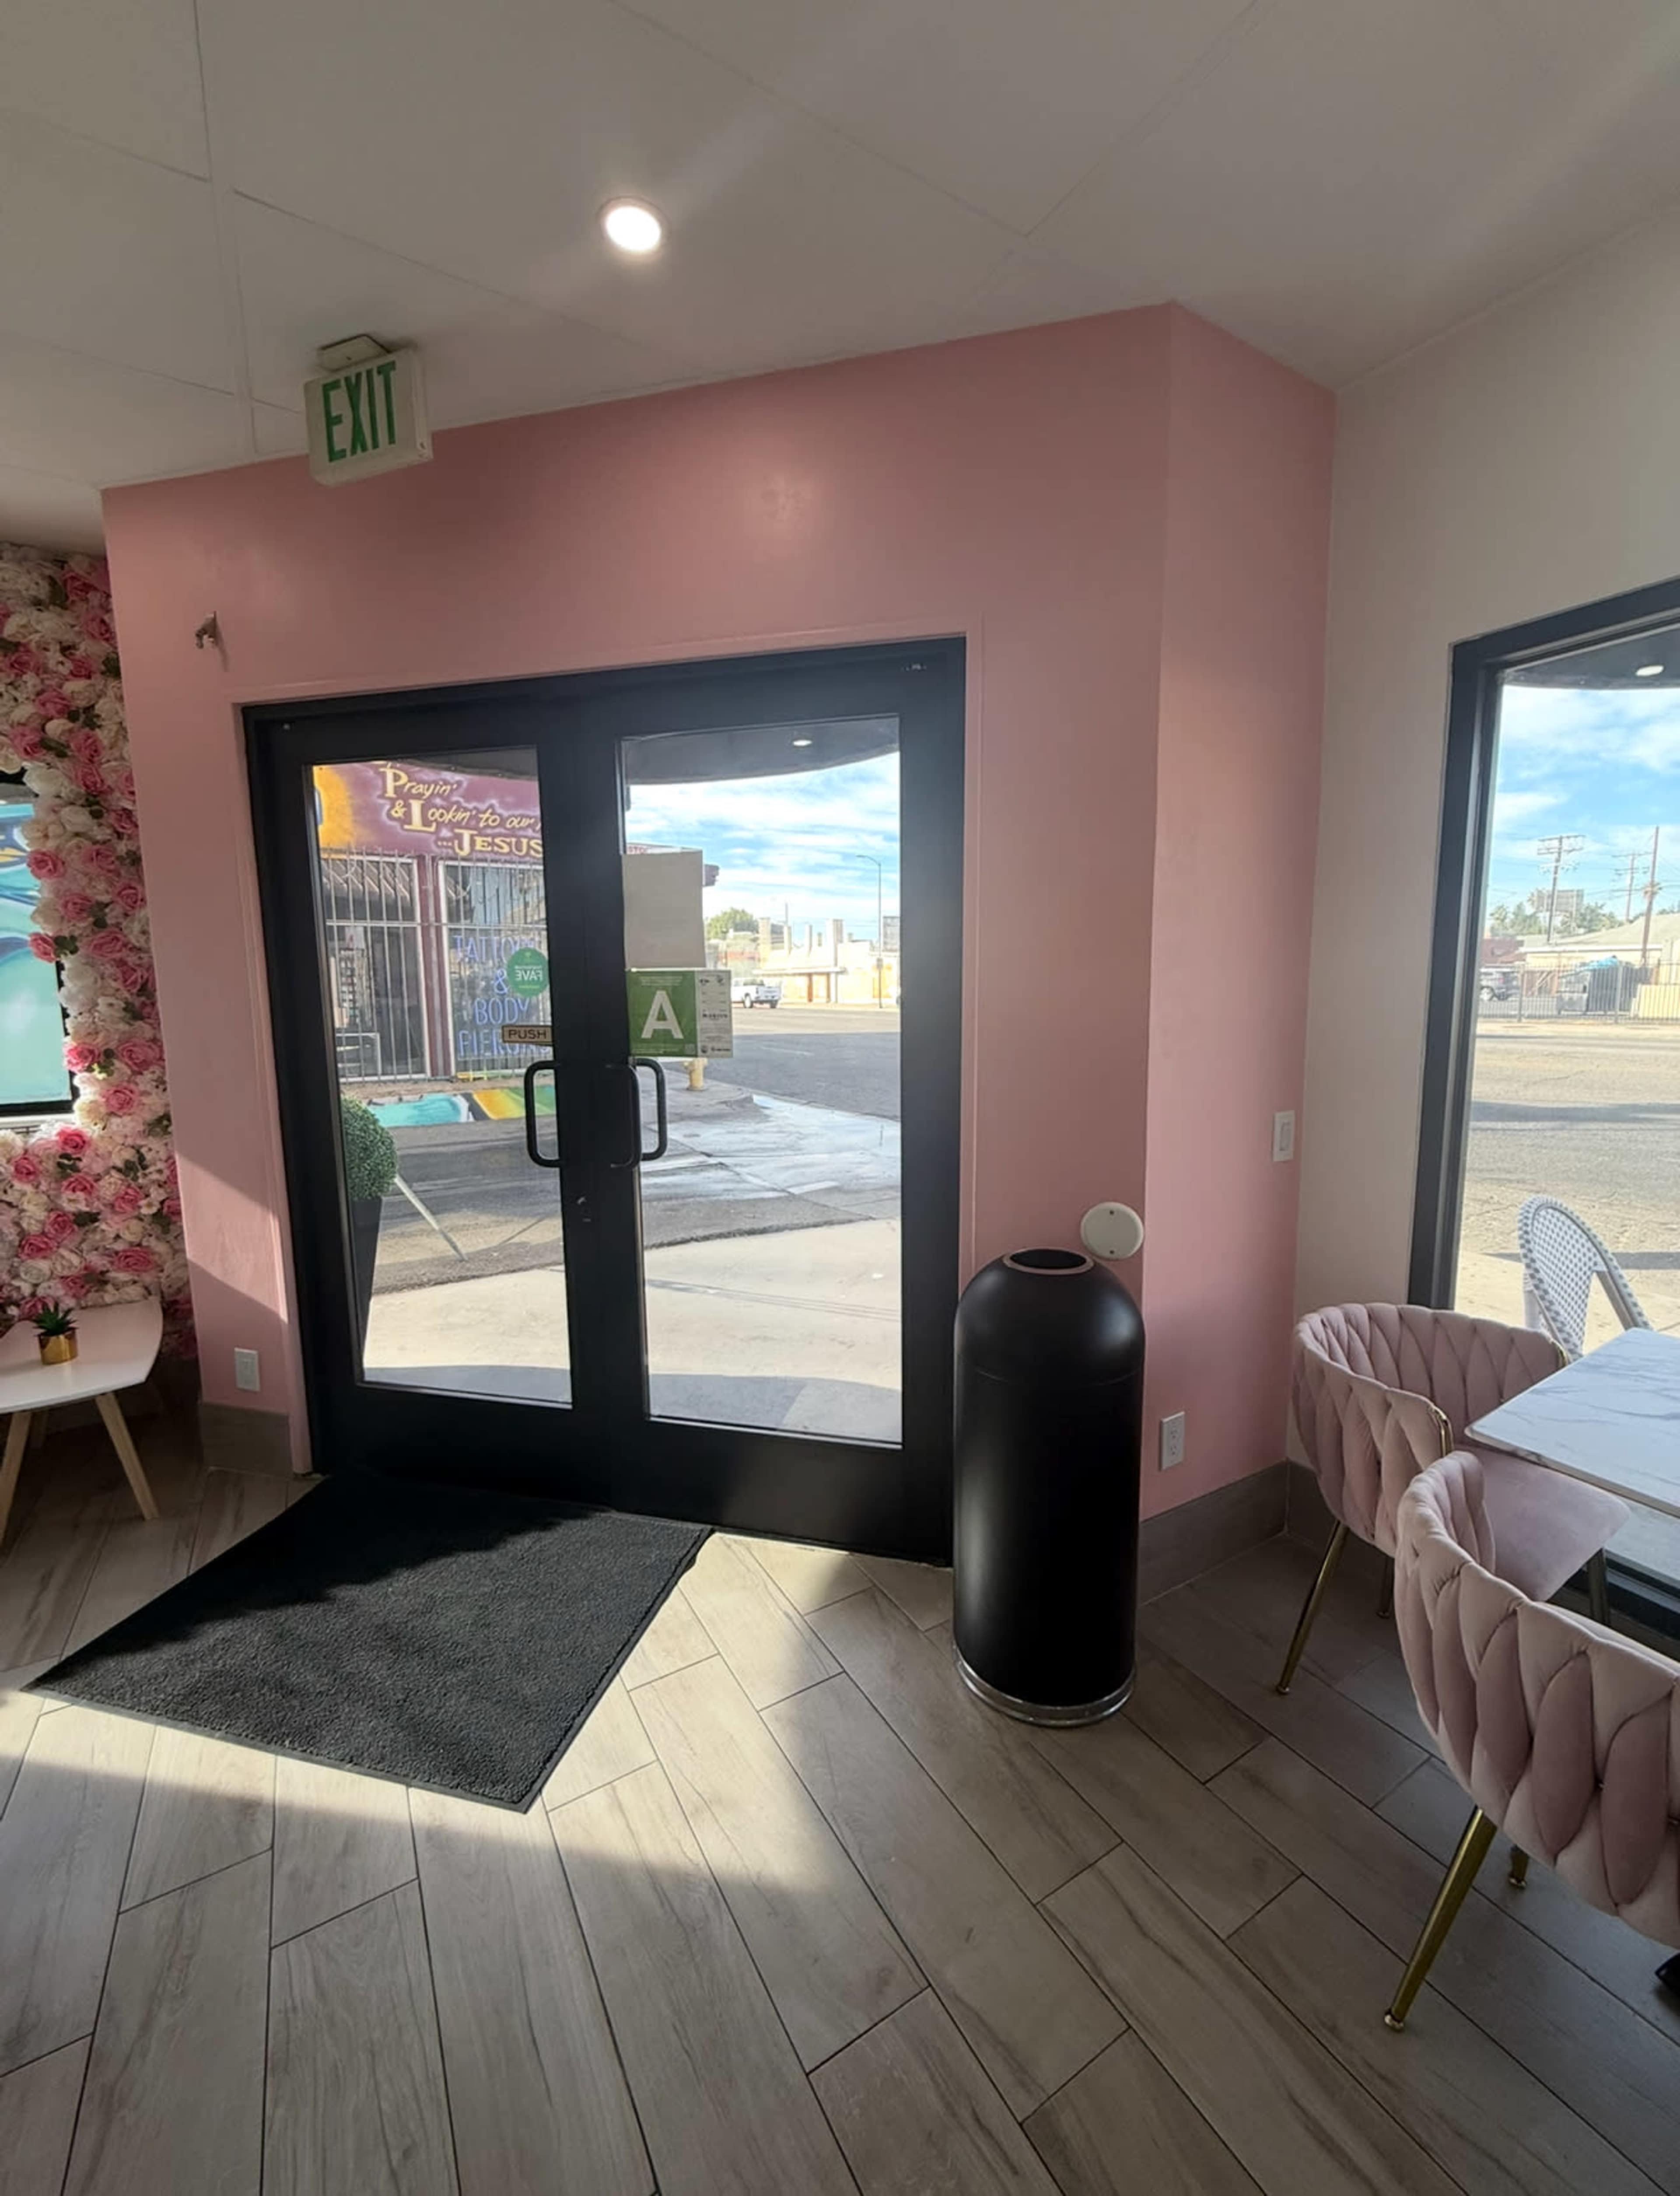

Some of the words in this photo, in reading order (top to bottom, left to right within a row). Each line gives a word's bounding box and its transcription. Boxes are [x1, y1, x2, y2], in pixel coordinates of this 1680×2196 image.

[322, 360, 396, 463] EXIT
[379, 768, 458, 799] Prayin'
[390, 800, 407, 819] &
[403, 799, 475, 832] Lookin'
[479, 808, 500, 827] to
[506, 816, 536, 829] our
[494, 969, 508, 995] &
[475, 997, 530, 1025] BODY
[641, 990, 684, 1039] A
[508, 1029, 547, 1039] PUSH
